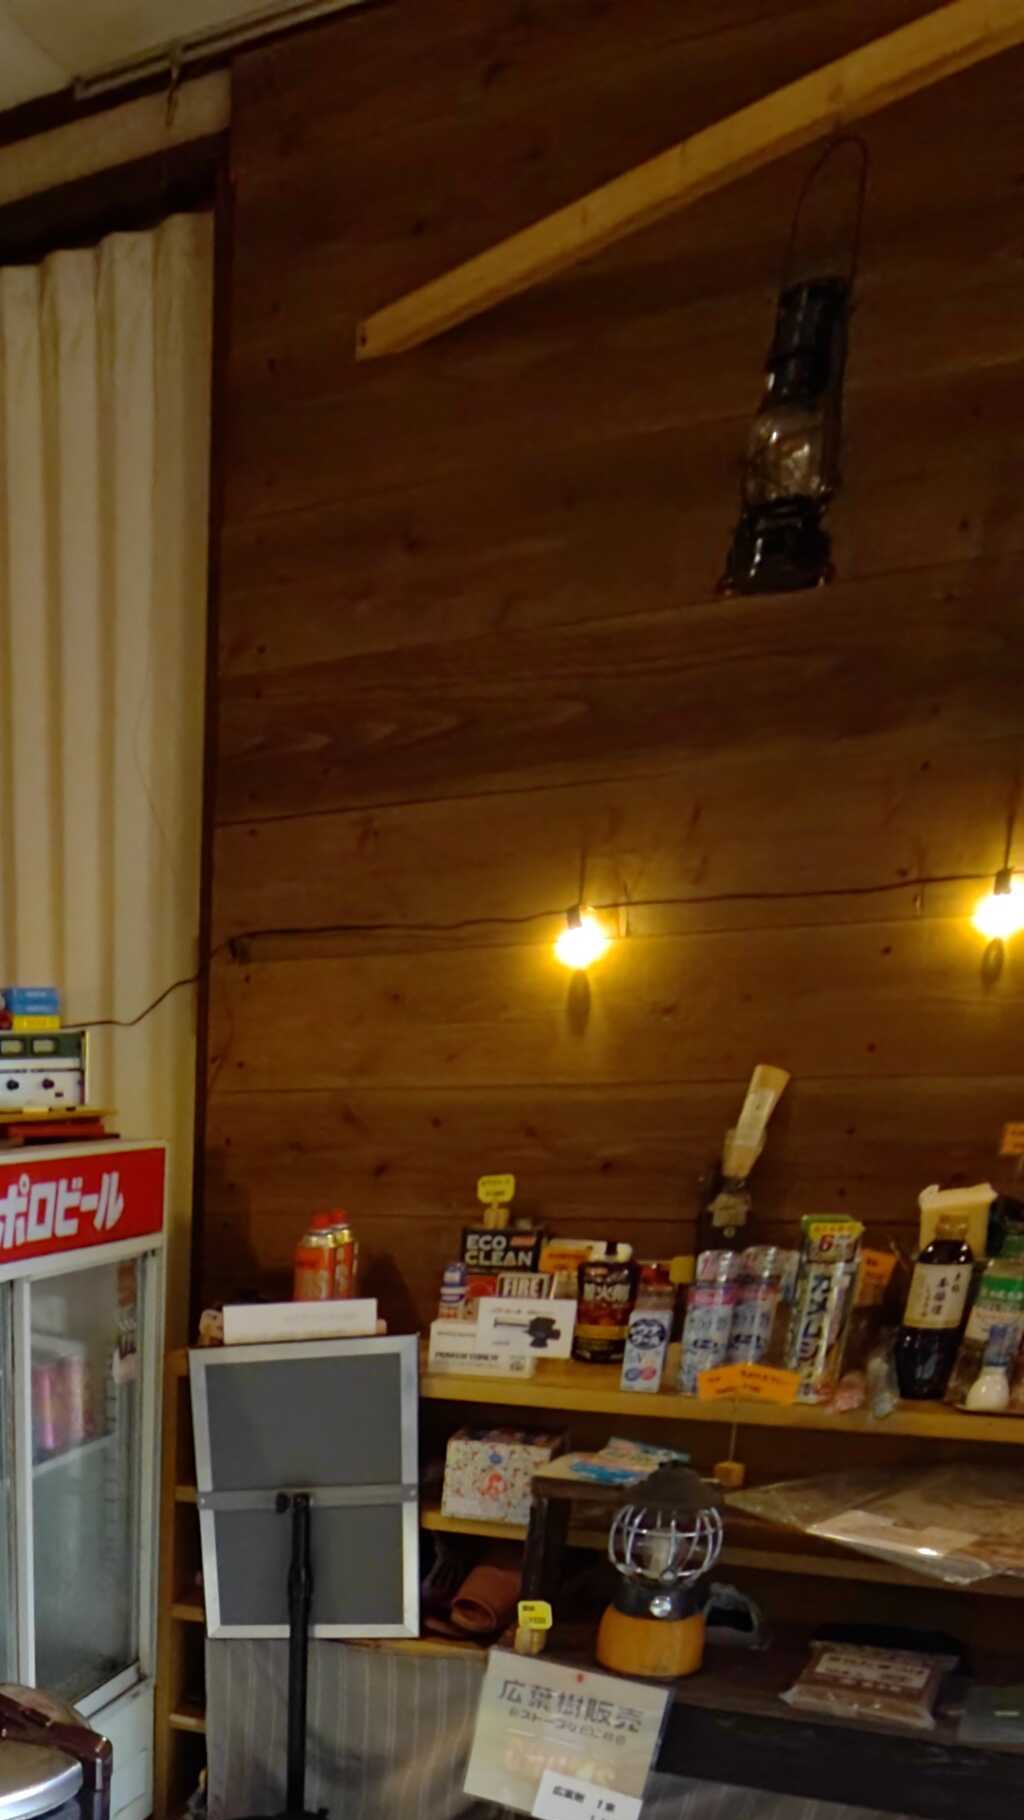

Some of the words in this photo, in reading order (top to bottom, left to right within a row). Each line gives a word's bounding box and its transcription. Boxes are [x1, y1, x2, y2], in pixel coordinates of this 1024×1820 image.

[466, 1234, 508, 1251] ECO
[465, 1250, 533, 1267] CLEAN
[502, 1277, 541, 1297] FIRE
[498, 1679, 643, 1734] 広葉樹販売
